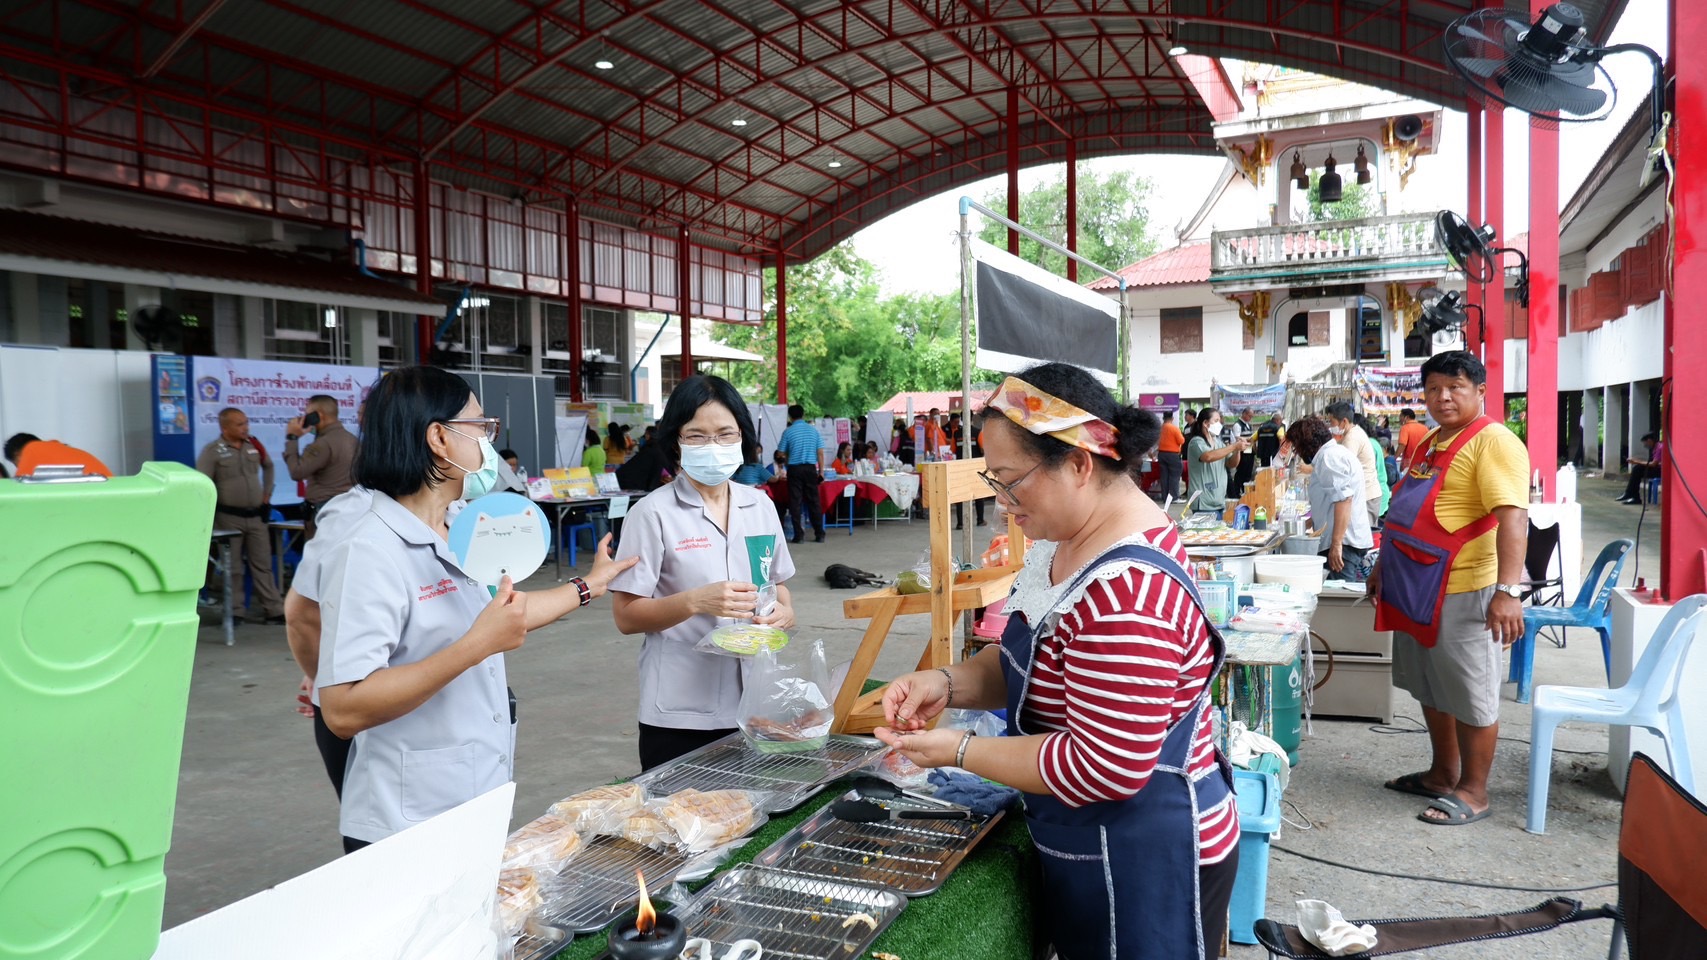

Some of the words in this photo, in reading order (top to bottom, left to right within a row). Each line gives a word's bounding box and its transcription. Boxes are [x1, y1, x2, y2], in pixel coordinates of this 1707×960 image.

[228, 371, 353, 391] โครงการโรงพักเคลื่อนที่
